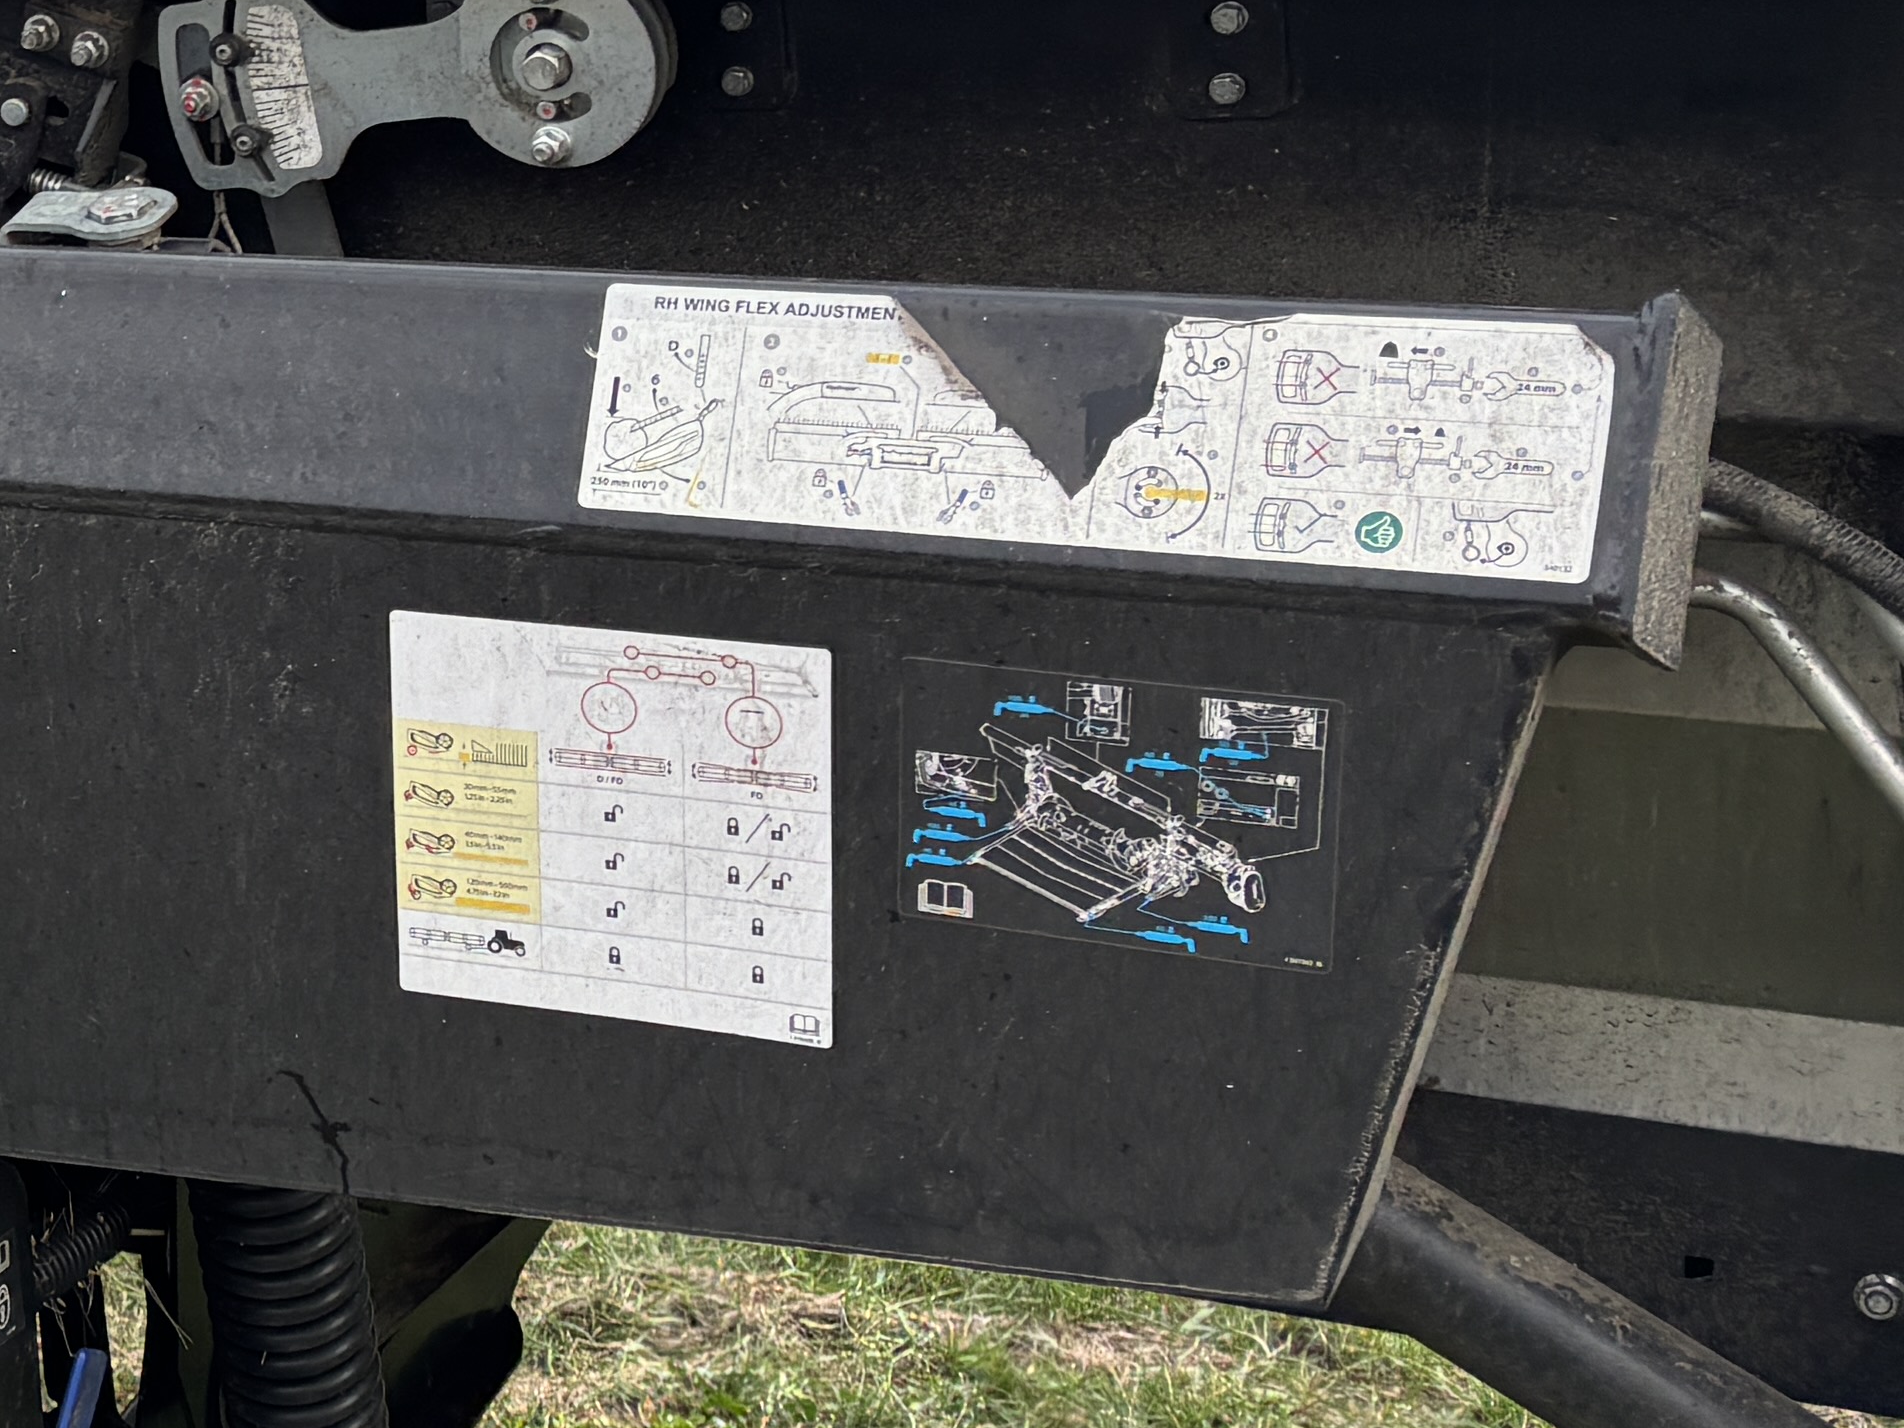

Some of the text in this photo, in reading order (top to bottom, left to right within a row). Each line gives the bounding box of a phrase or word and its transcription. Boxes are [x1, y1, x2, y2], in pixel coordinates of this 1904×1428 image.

[653, 295, 903, 322] RH WING FLEX ADJUSTMEN
[667, 339, 679, 352] D
